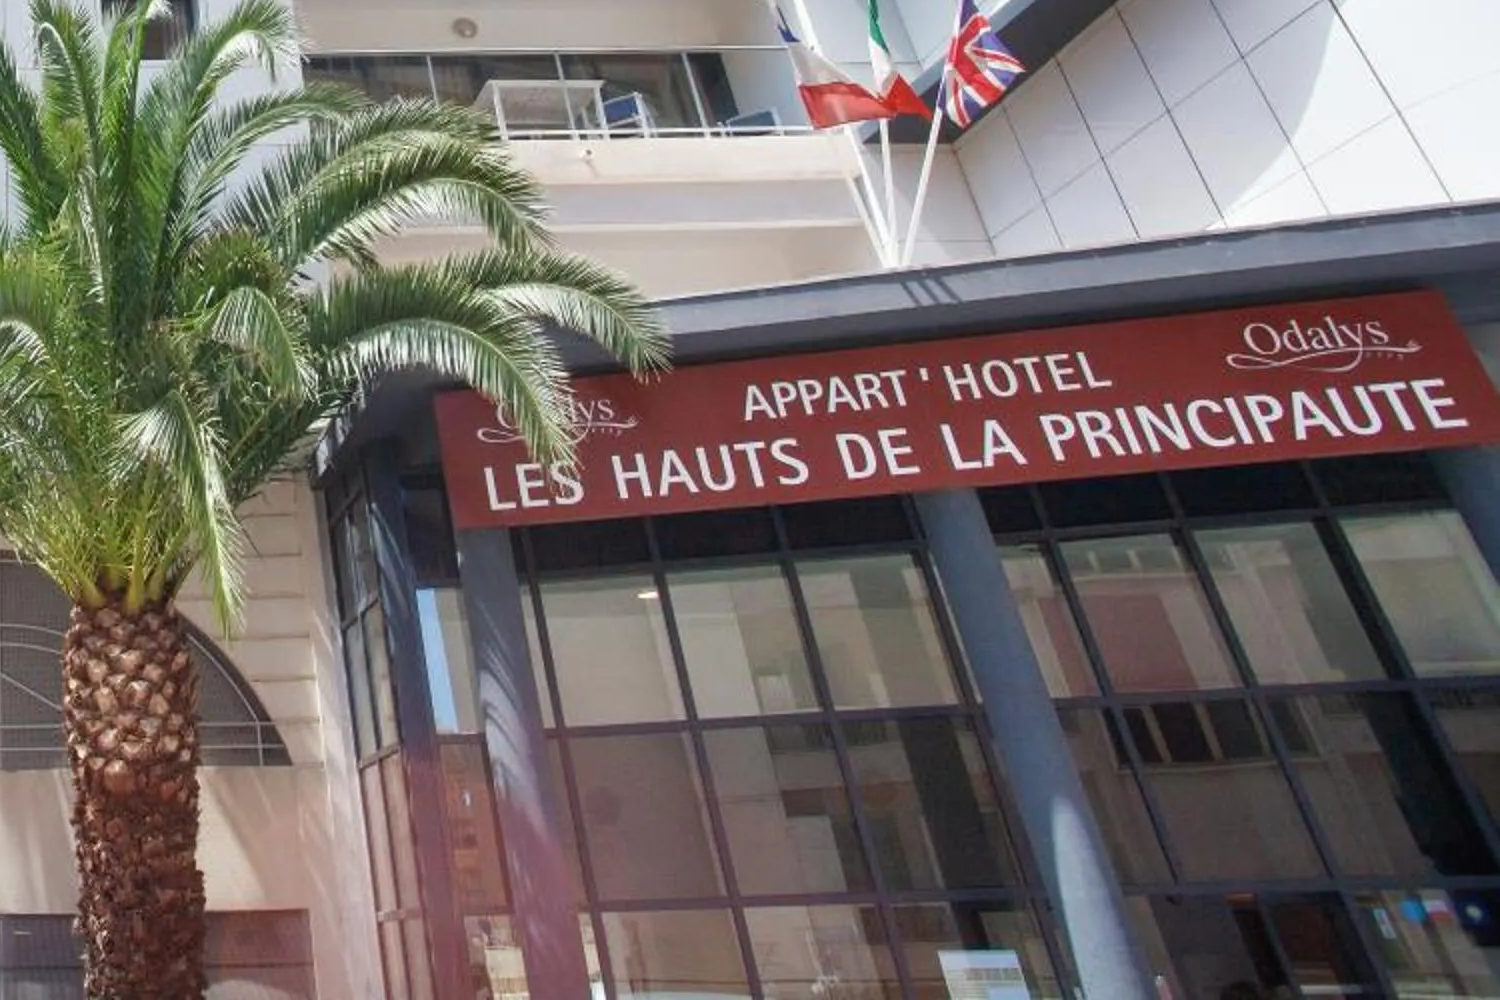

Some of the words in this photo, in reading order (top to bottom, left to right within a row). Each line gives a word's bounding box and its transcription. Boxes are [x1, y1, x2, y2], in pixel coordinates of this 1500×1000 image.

[1243, 316, 1389, 372] Odalys
[483, 459, 585, 511] LES
[611, 437, 810, 499] HAUTS
[835, 428, 921, 480] DE
[940, 419, 1028, 471] LA
[1039, 378, 1469, 462] PRINCIPAUTE
